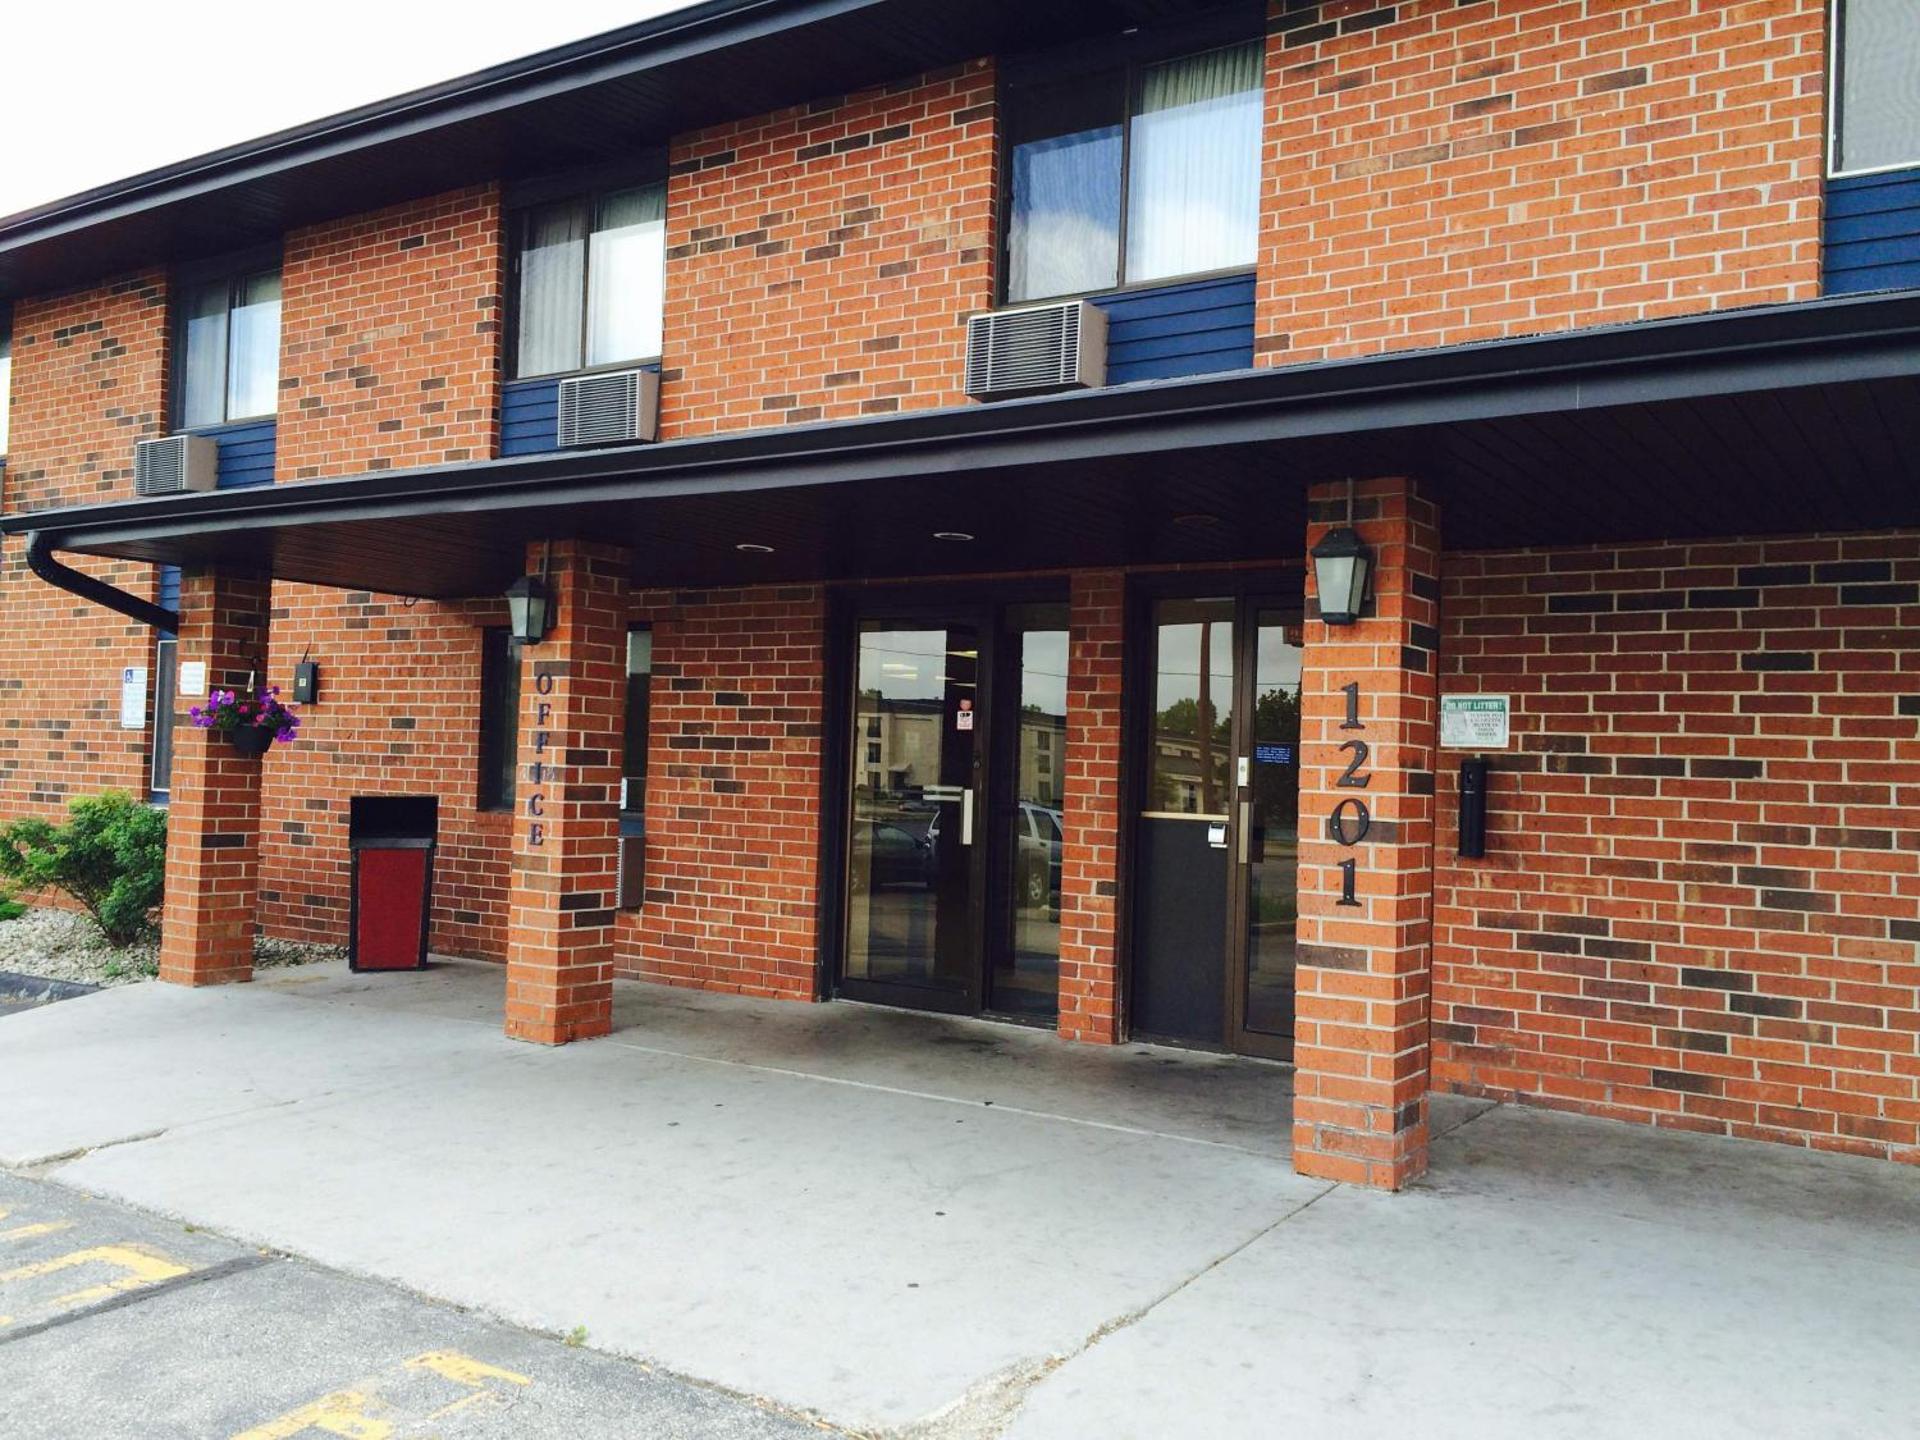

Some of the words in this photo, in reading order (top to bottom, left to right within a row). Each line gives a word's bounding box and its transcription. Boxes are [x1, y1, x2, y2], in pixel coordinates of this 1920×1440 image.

[529, 673, 552, 846] OFFICE
[1457, 701, 1472, 710] NOT
[1473, 700, 1503, 710] LITTER!
[1330, 681, 1371, 907] 1201
